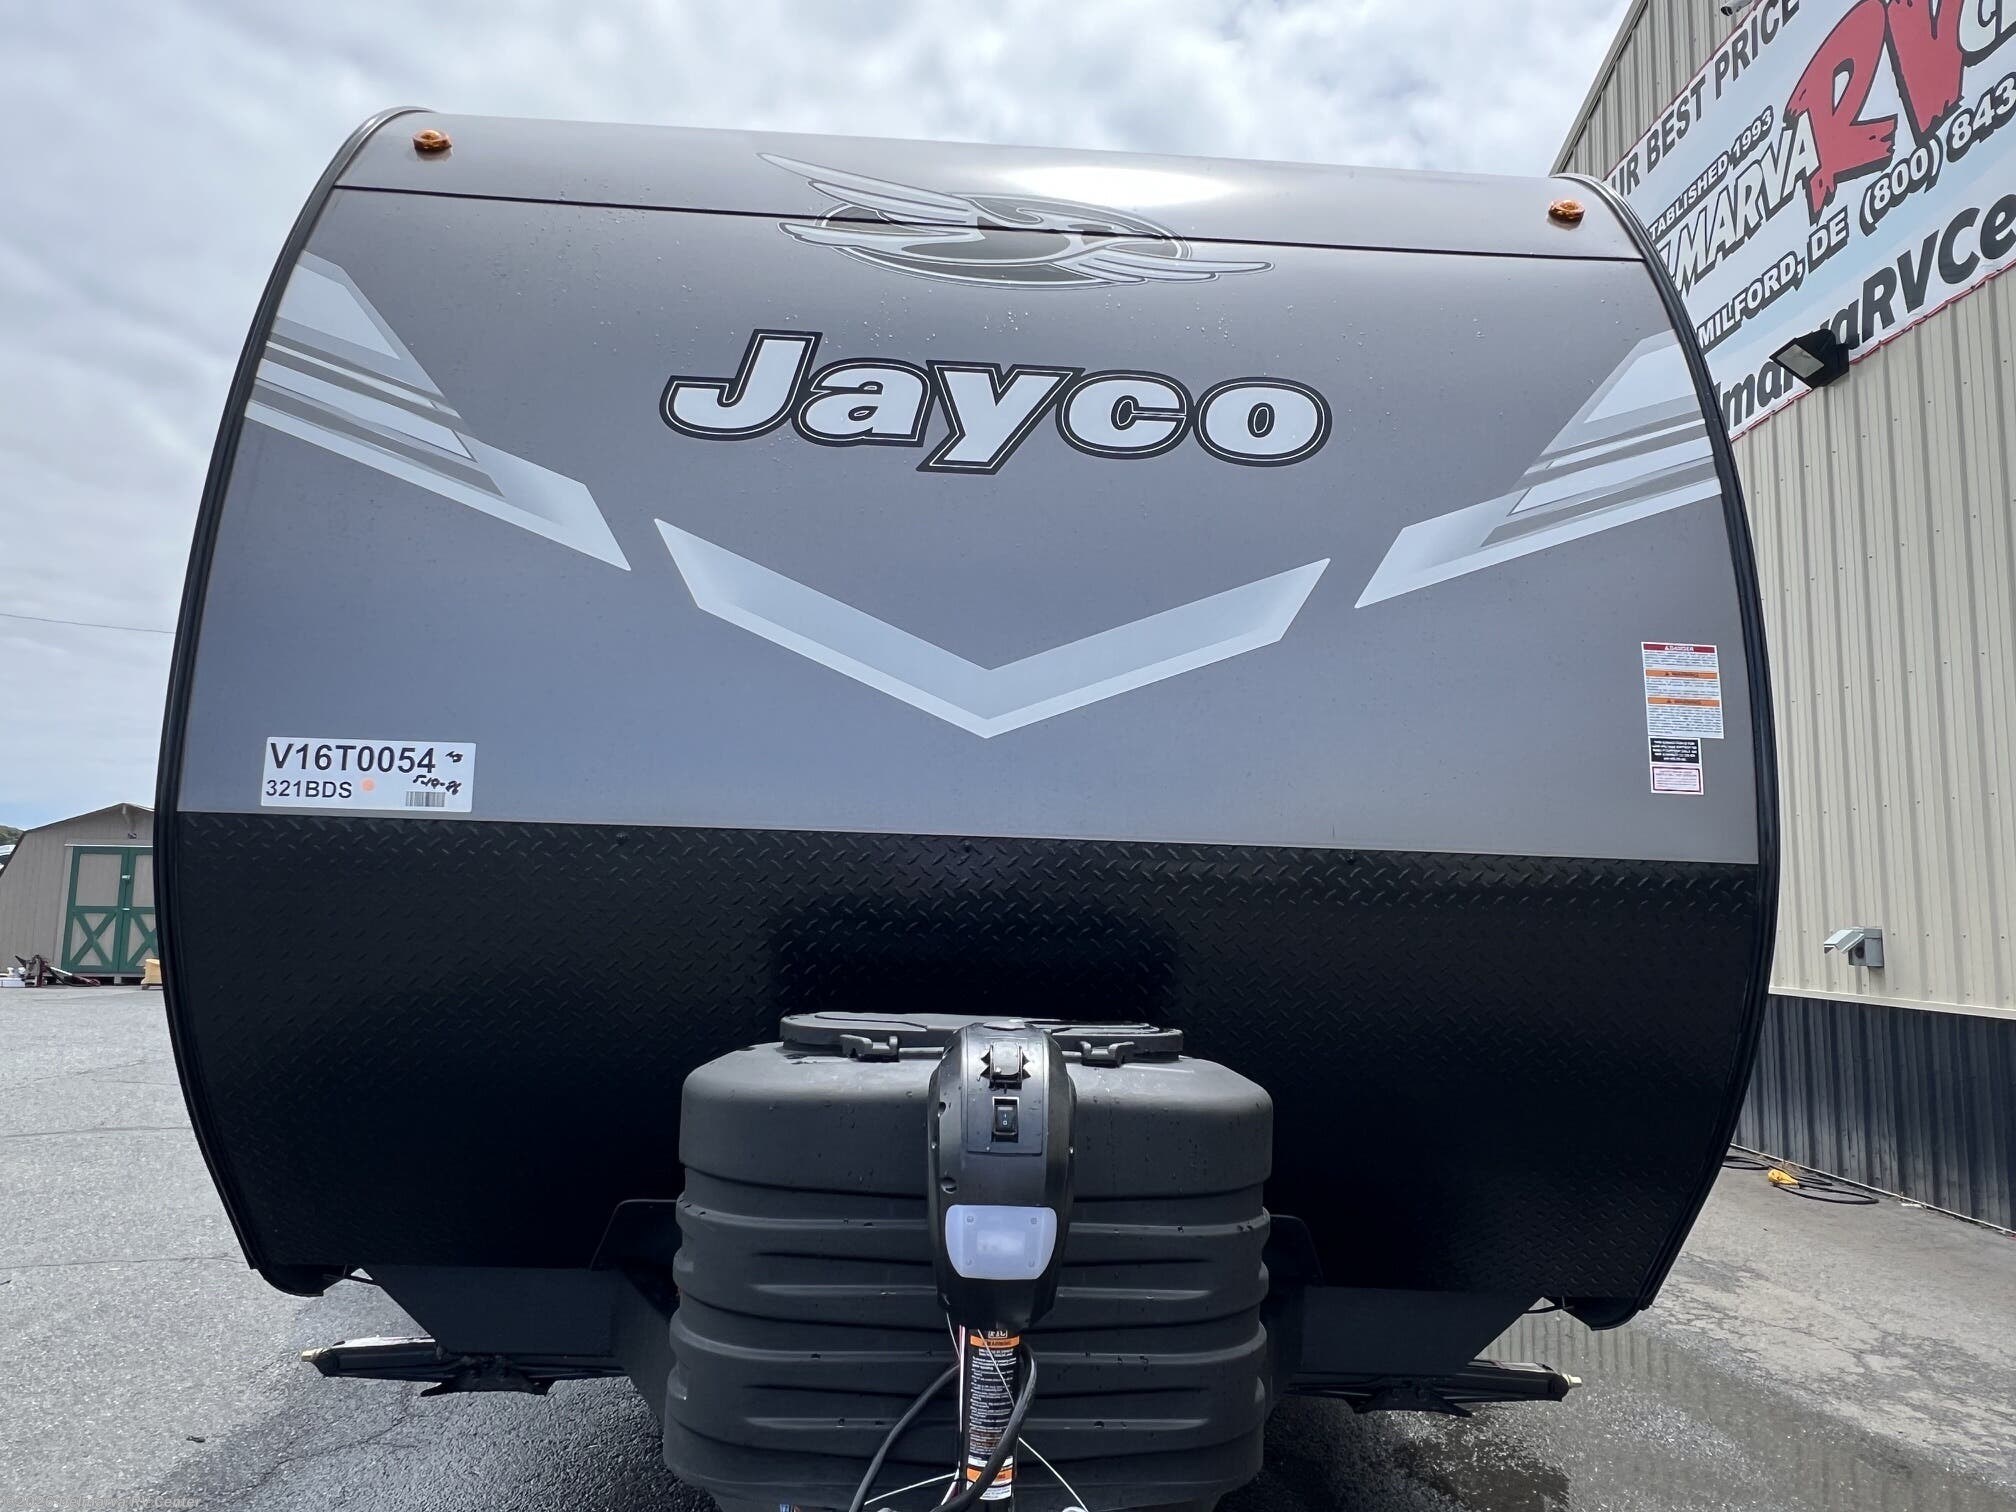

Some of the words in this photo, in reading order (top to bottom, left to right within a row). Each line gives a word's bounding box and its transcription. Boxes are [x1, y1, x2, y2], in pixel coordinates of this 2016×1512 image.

[1647, 72, 1706, 175] BEST
[1731, 106, 1774, 165] 1993
[1697, 251, 1805, 353] MILFORD,
[1808, 206, 1850, 272] DE
[1861, 134, 1943, 234] (800)
[659, 329, 1333, 475] Jayco
[266, 779, 353, 799] 321BDS
[270, 743, 436, 774] V16T0054
